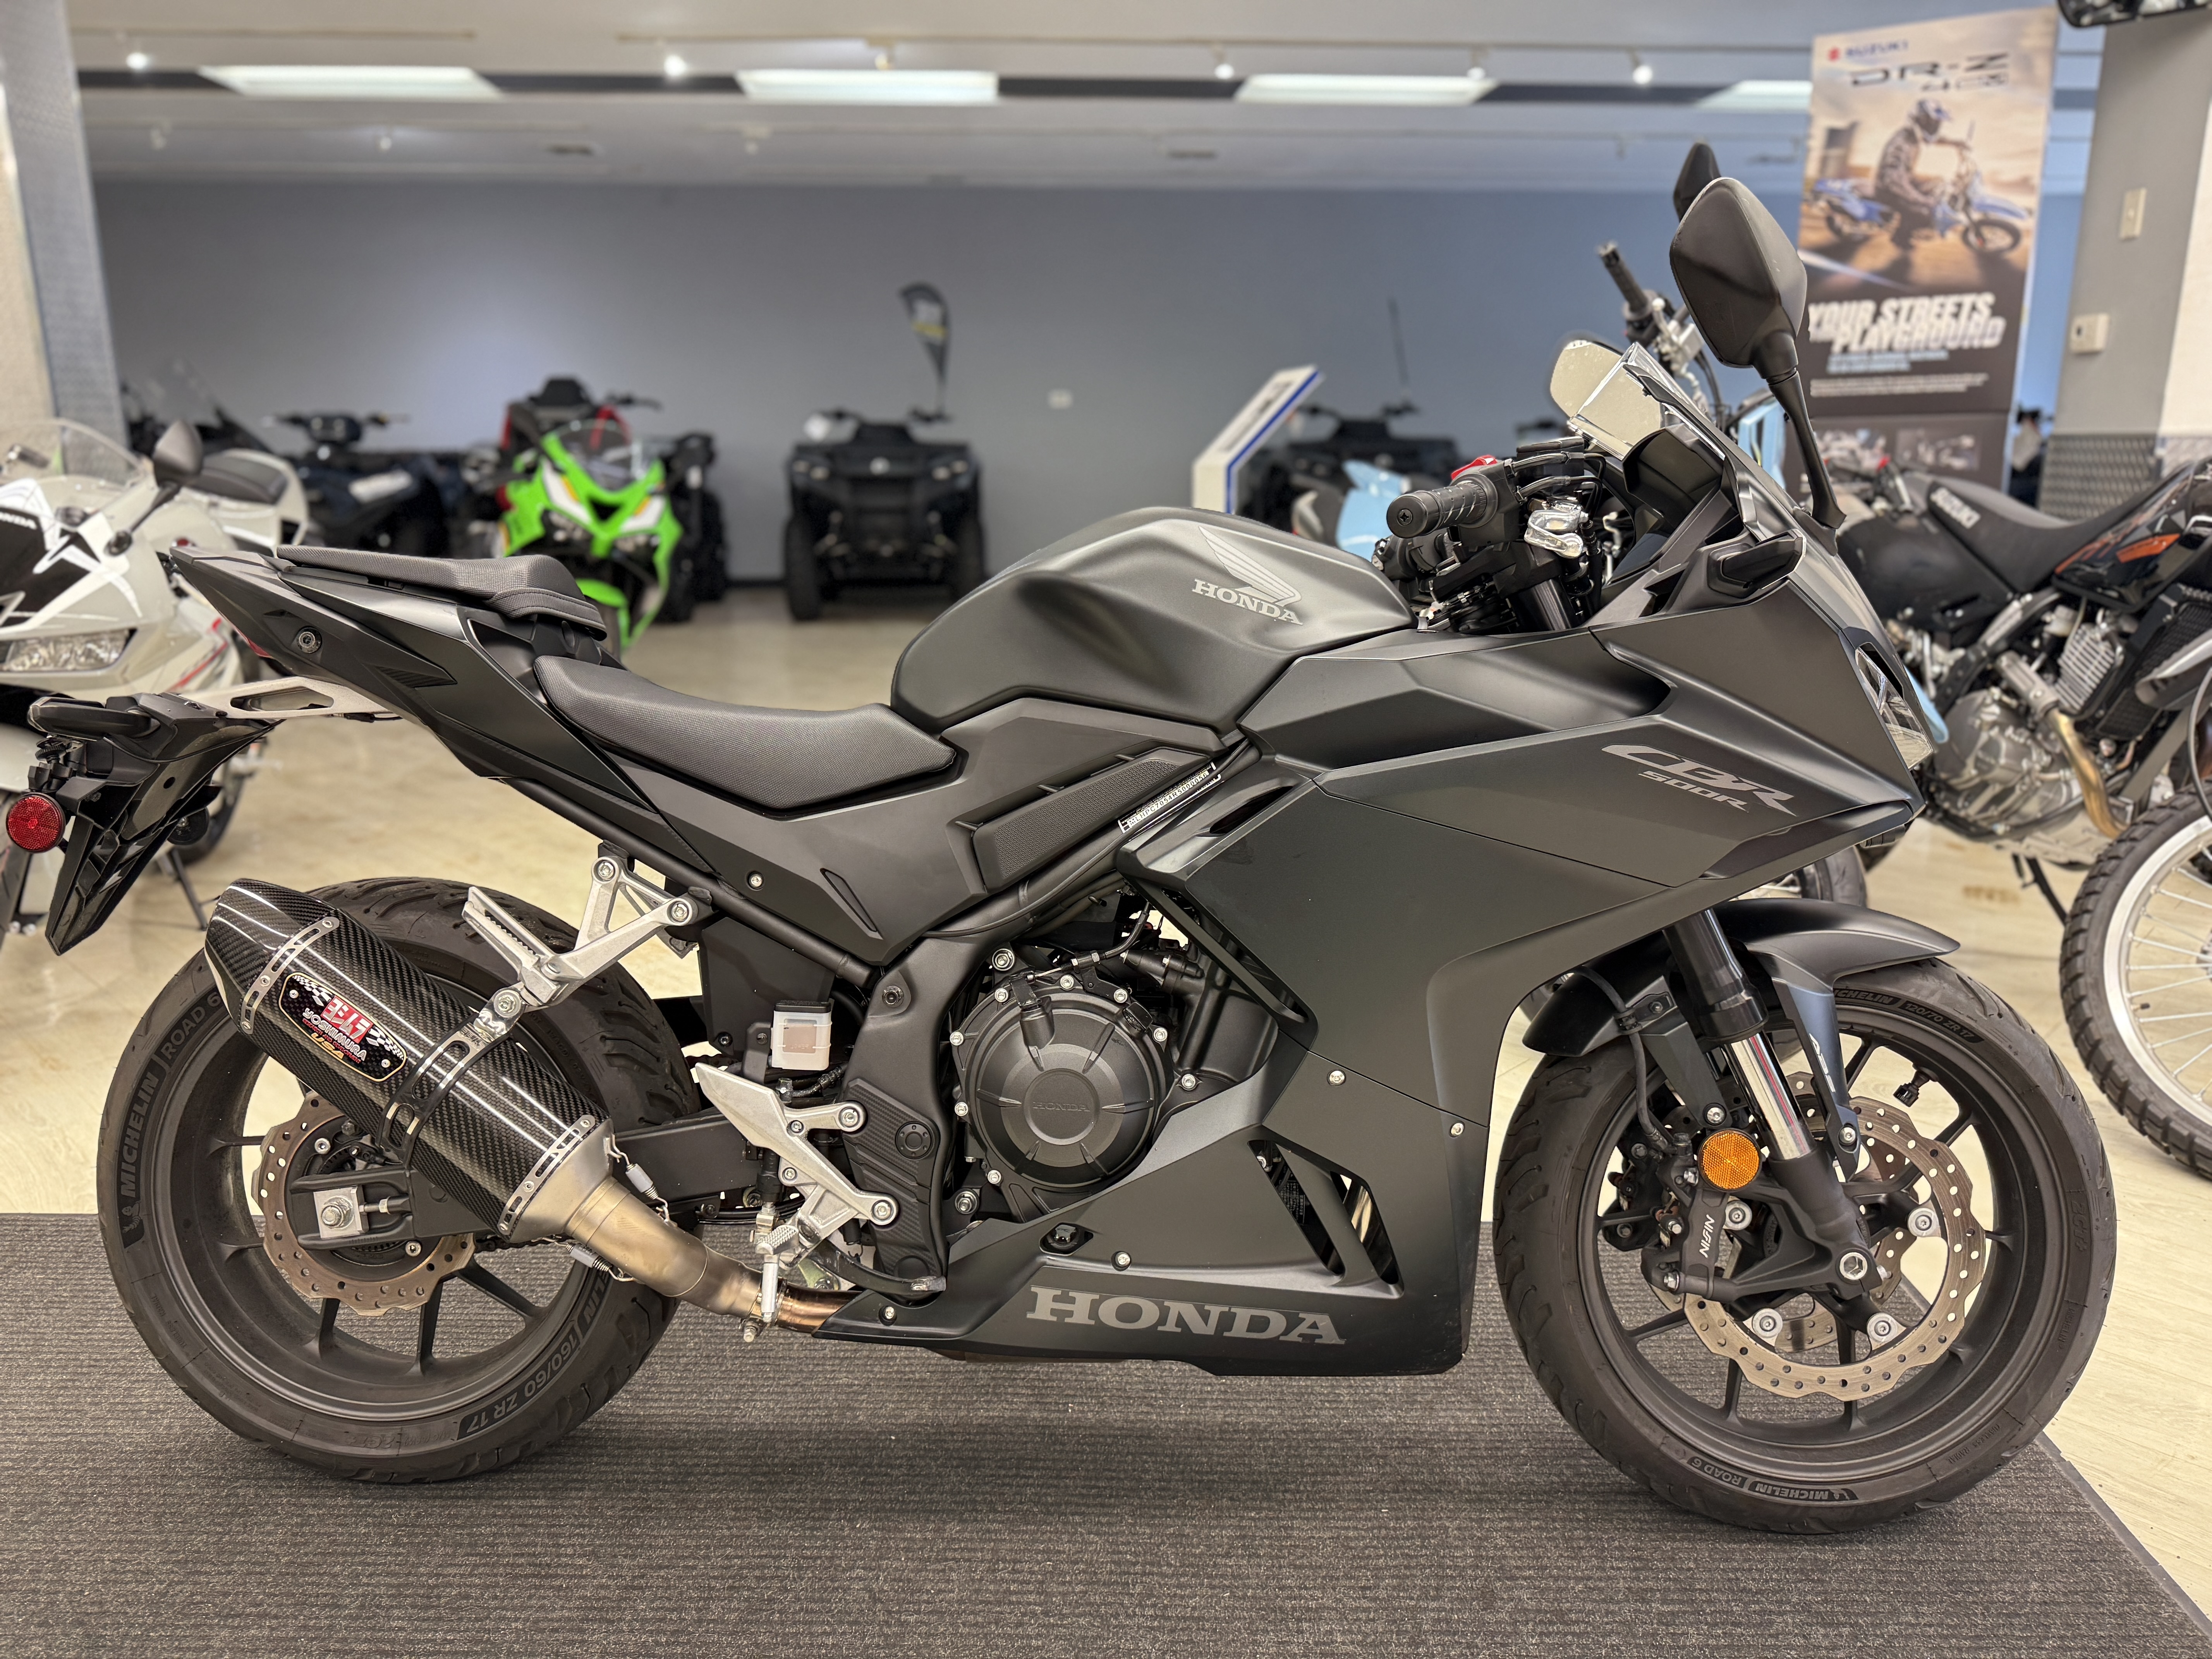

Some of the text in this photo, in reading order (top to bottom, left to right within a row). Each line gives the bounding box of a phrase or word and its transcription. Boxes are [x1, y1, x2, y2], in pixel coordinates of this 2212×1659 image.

[1879, 292, 1996, 324] STREETS
[1831, 316, 2007, 354] PLAYGROUND
[1192, 579, 1303, 625] HONDA
[1601, 744, 1798, 817] CBR
[1638, 770, 1749, 813] 500R
[302, 1008, 367, 1061] YOSHIMURA
[323, 998, 371, 1039] ヨシムラ
[1905, 1003, 1975, 1038] 120/70 ZR 17
[311, 1032, 344, 1059] USA
[323, 1034, 333, 1043] AND
[332, 1040, 361, 1064] DEVELOPMENT
[1809, 1033, 1836, 1092] ABS
[121, 992, 221, 1198] MICHELIN ROAD 6
[1033, 1102, 1091, 1111] HONDA
[1699, 1214, 1715, 1258] NISSIN
[1026, 1286, 1346, 1345] HONDA
[466, 1335, 577, 1433] 160/60 ZR 17
[1947, 1446, 1970, 1465] RADIAL
[1691, 1458, 1829, 1500] MICHELIN ROAD 6
